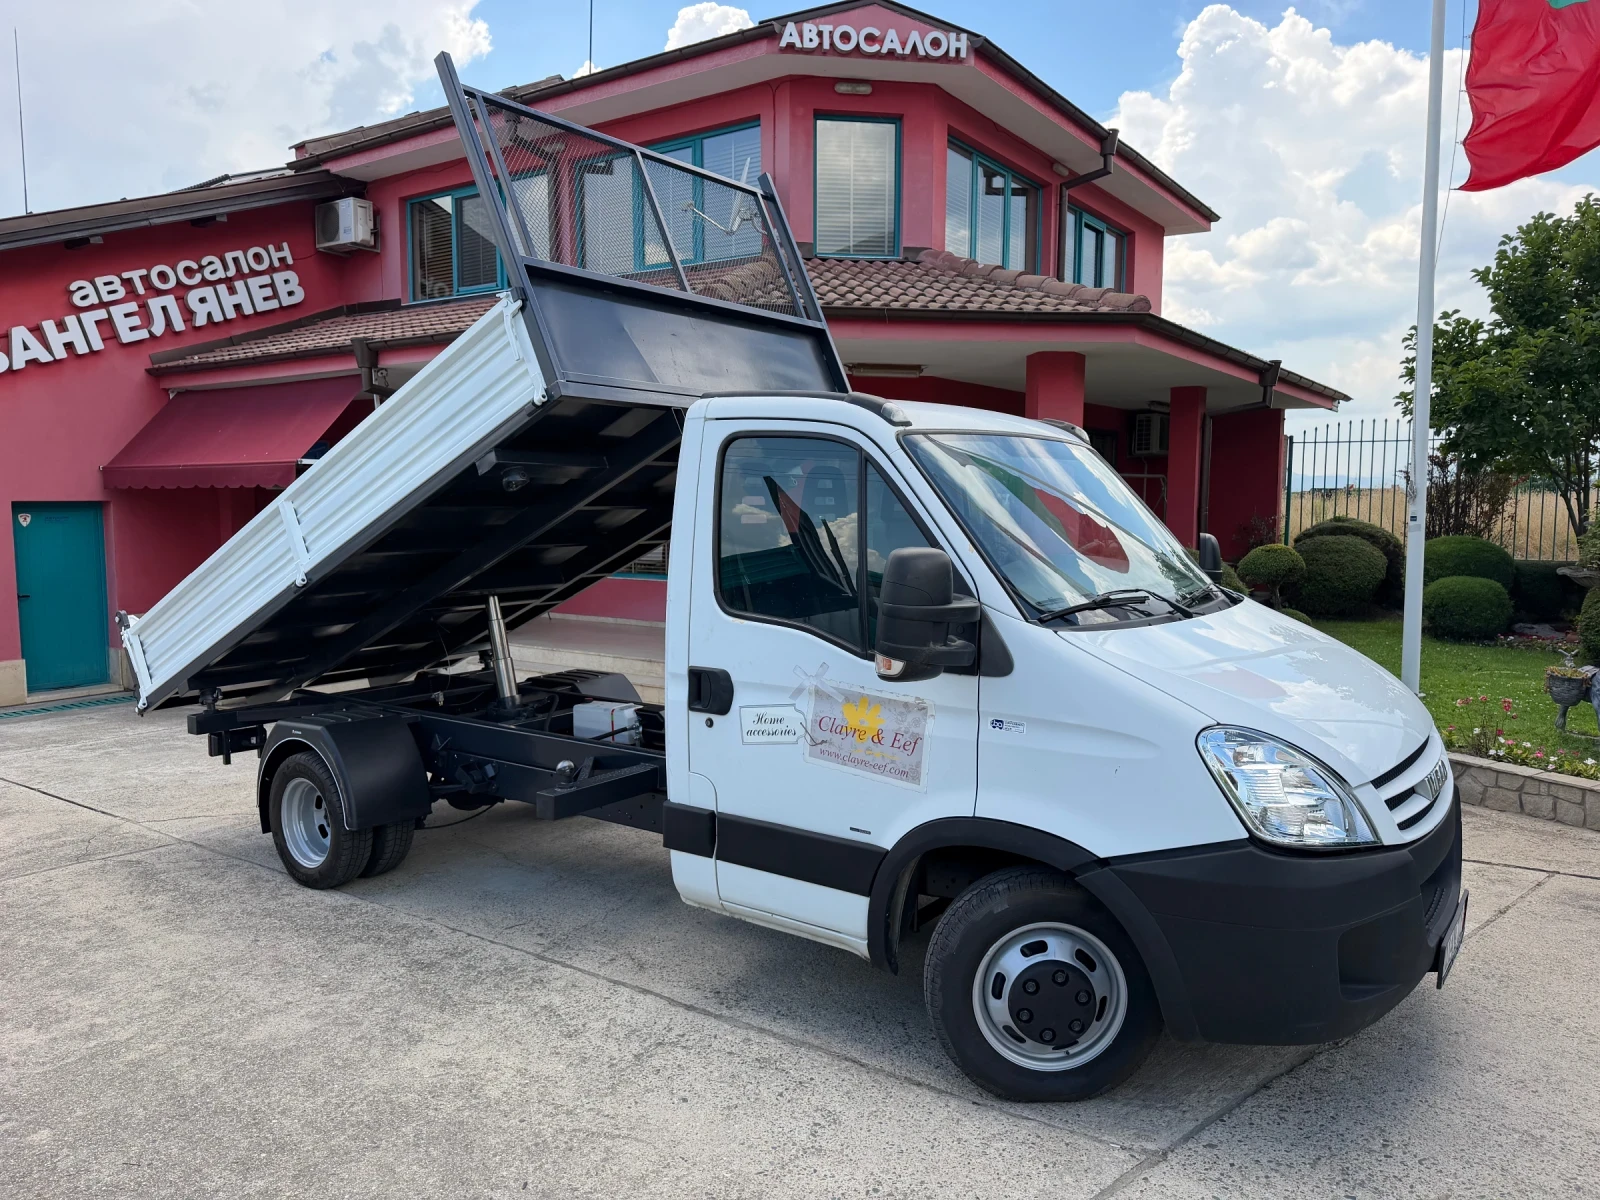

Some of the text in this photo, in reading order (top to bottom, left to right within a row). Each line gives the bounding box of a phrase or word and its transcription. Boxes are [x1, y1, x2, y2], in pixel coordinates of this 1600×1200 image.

[779, 21, 968, 60] АВТОСАЛОН
[69, 241, 294, 307] автосалон
[185, 270, 305, 327] ЯНЕВ
[746, 725, 797, 737] accessories
[752, 711, 785, 725] Home
[818, 715, 922, 757] Clayre & Eef
[820, 747, 909, 778] www.clayre-eef.com
